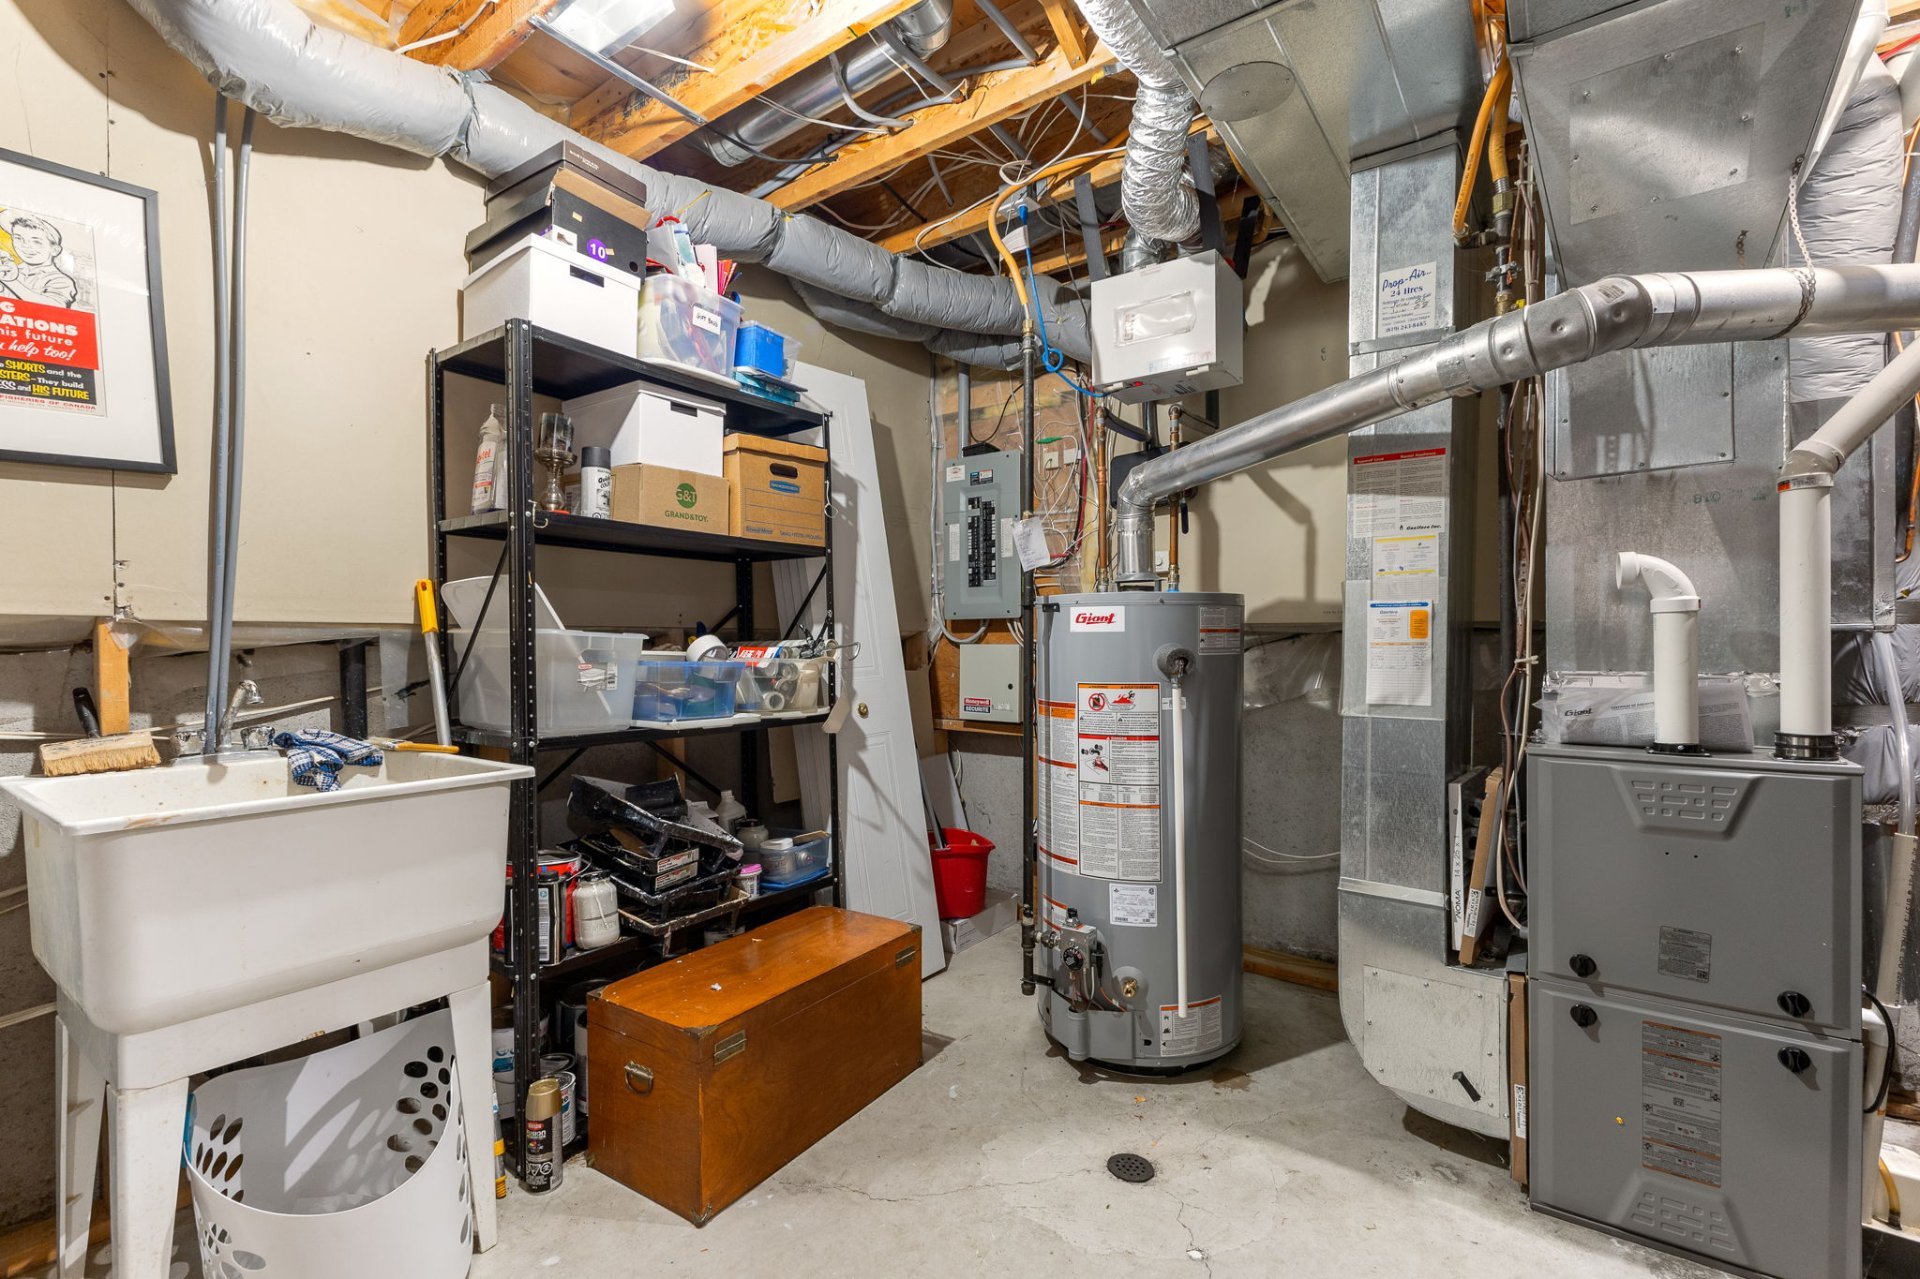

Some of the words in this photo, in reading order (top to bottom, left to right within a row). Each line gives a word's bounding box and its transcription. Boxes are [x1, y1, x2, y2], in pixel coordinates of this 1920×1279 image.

[590, 243, 606, 259] 10
[25, 330, 73, 346] future
[8, 340, 40, 358] help
[44, 346, 76, 360] too!
[5, 360, 46, 374] SHORTS
[66, 370, 82, 379] the
[32, 384, 50, 396] HIS
[52, 386, 90, 400] FUTURE
[62, 380, 84, 390] build
[676, 488, 696, 502] G&T
[1076, 613, 1116, 624] Giant
[1564, 708, 1592, 716] Giant
